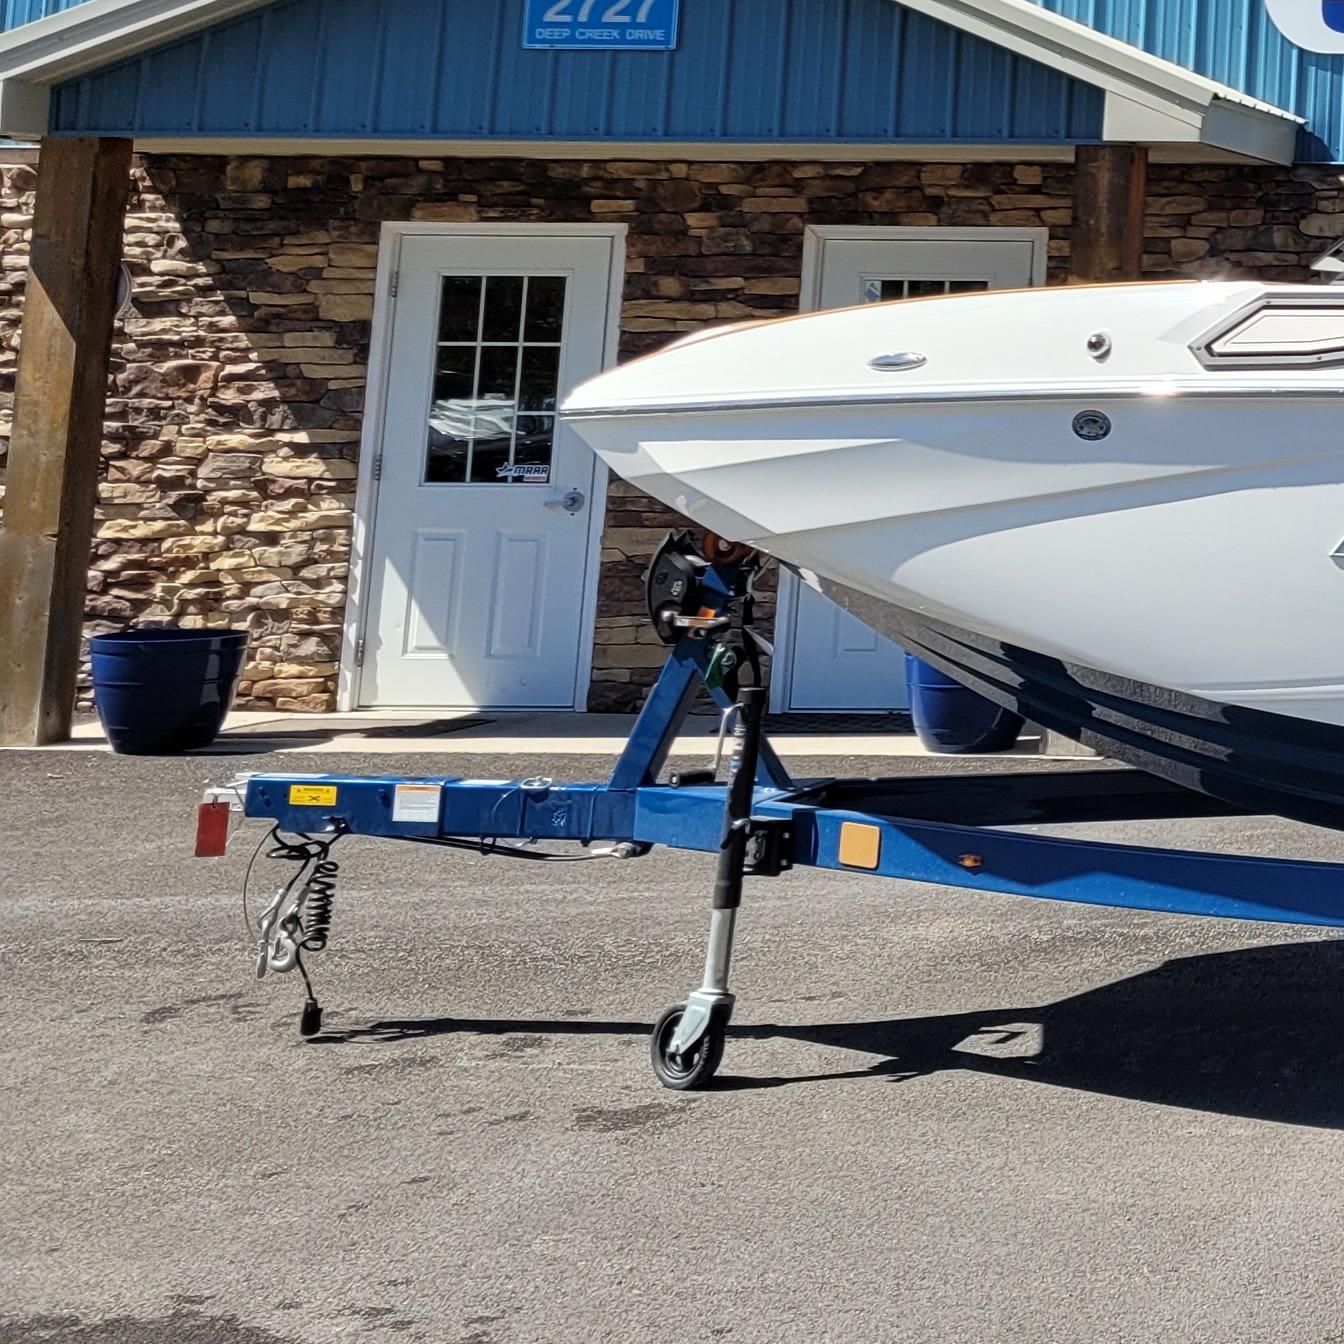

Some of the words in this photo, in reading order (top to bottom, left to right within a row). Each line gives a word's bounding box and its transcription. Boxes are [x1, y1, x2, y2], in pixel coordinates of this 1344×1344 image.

[535, 28, 571, 40] DEEP
[575, 28, 620, 40] CREEK
[625, 29, 665, 41] DRIVE
